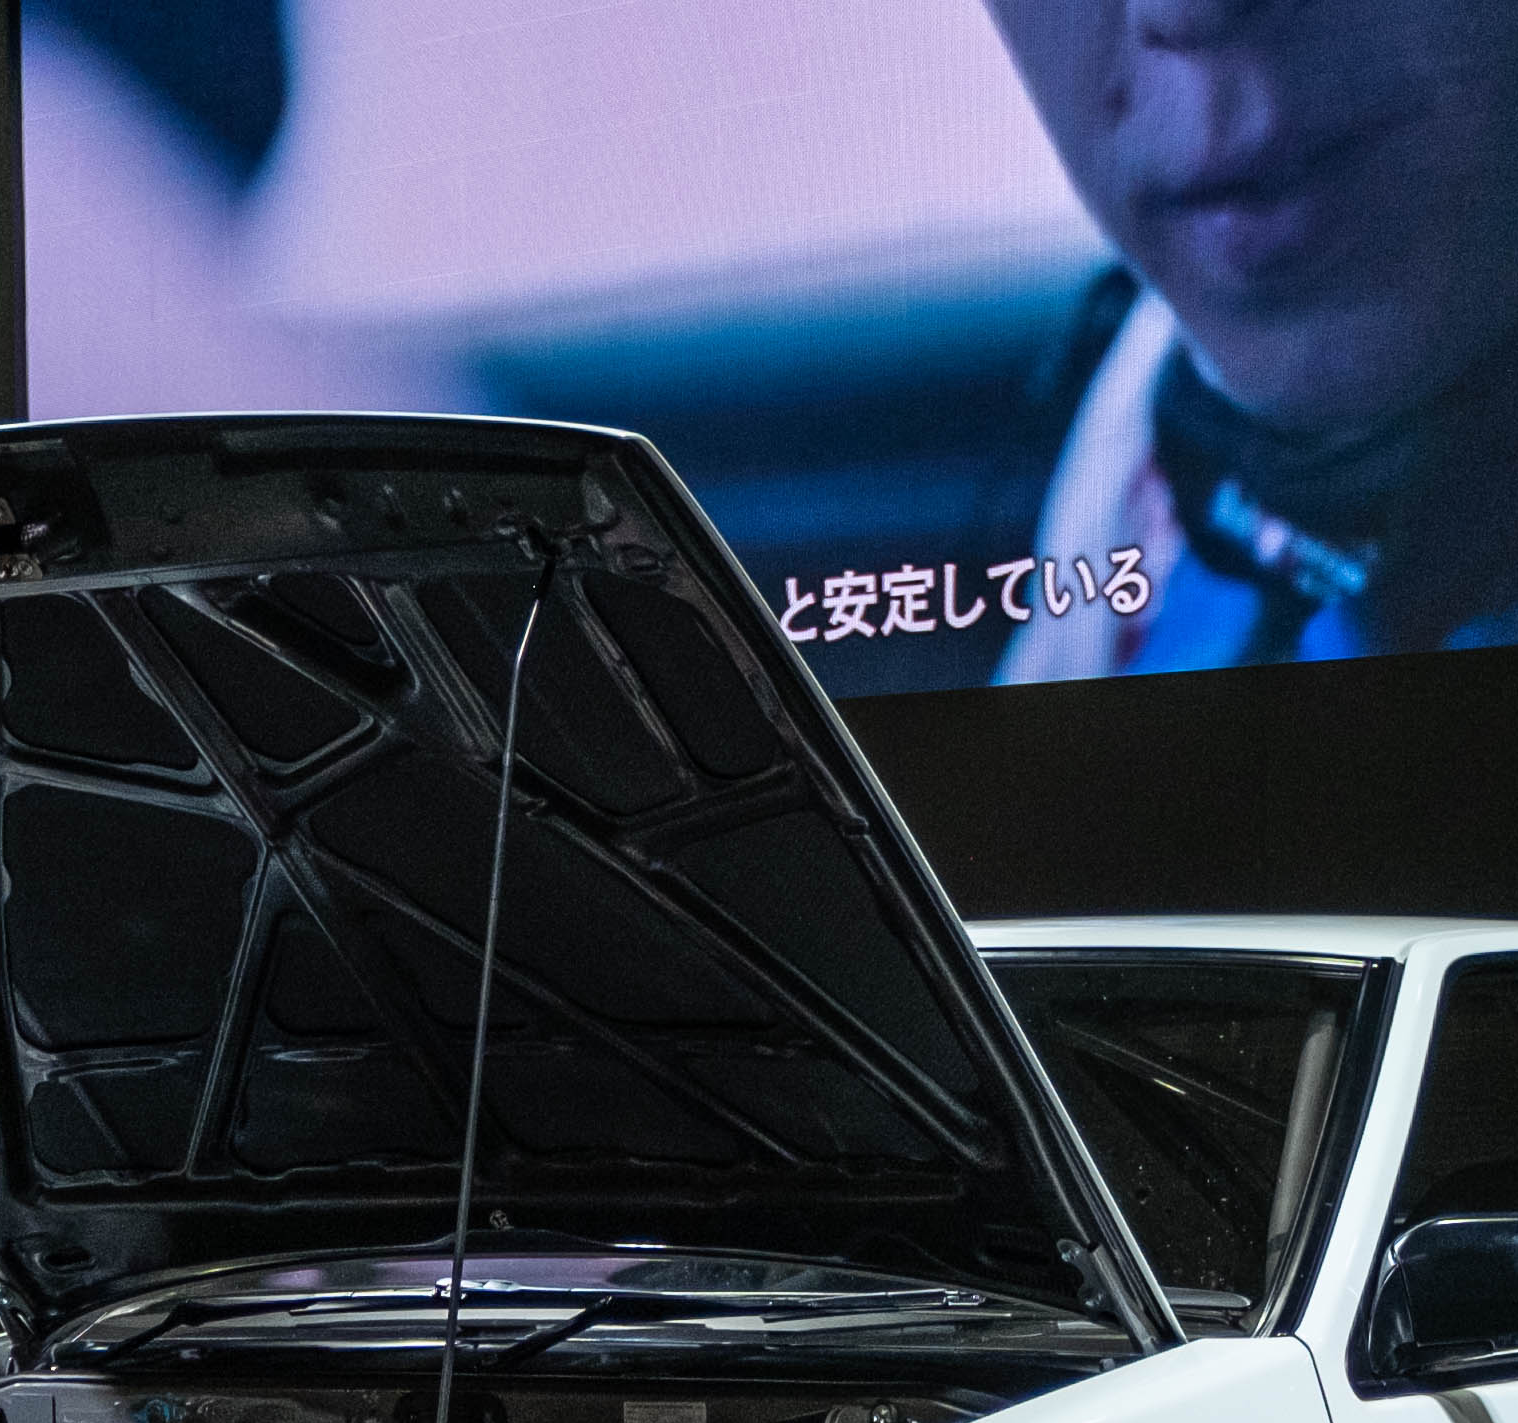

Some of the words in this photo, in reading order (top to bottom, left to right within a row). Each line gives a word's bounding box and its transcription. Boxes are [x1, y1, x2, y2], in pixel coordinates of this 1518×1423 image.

[781, 546, 1152, 642] と安定している
